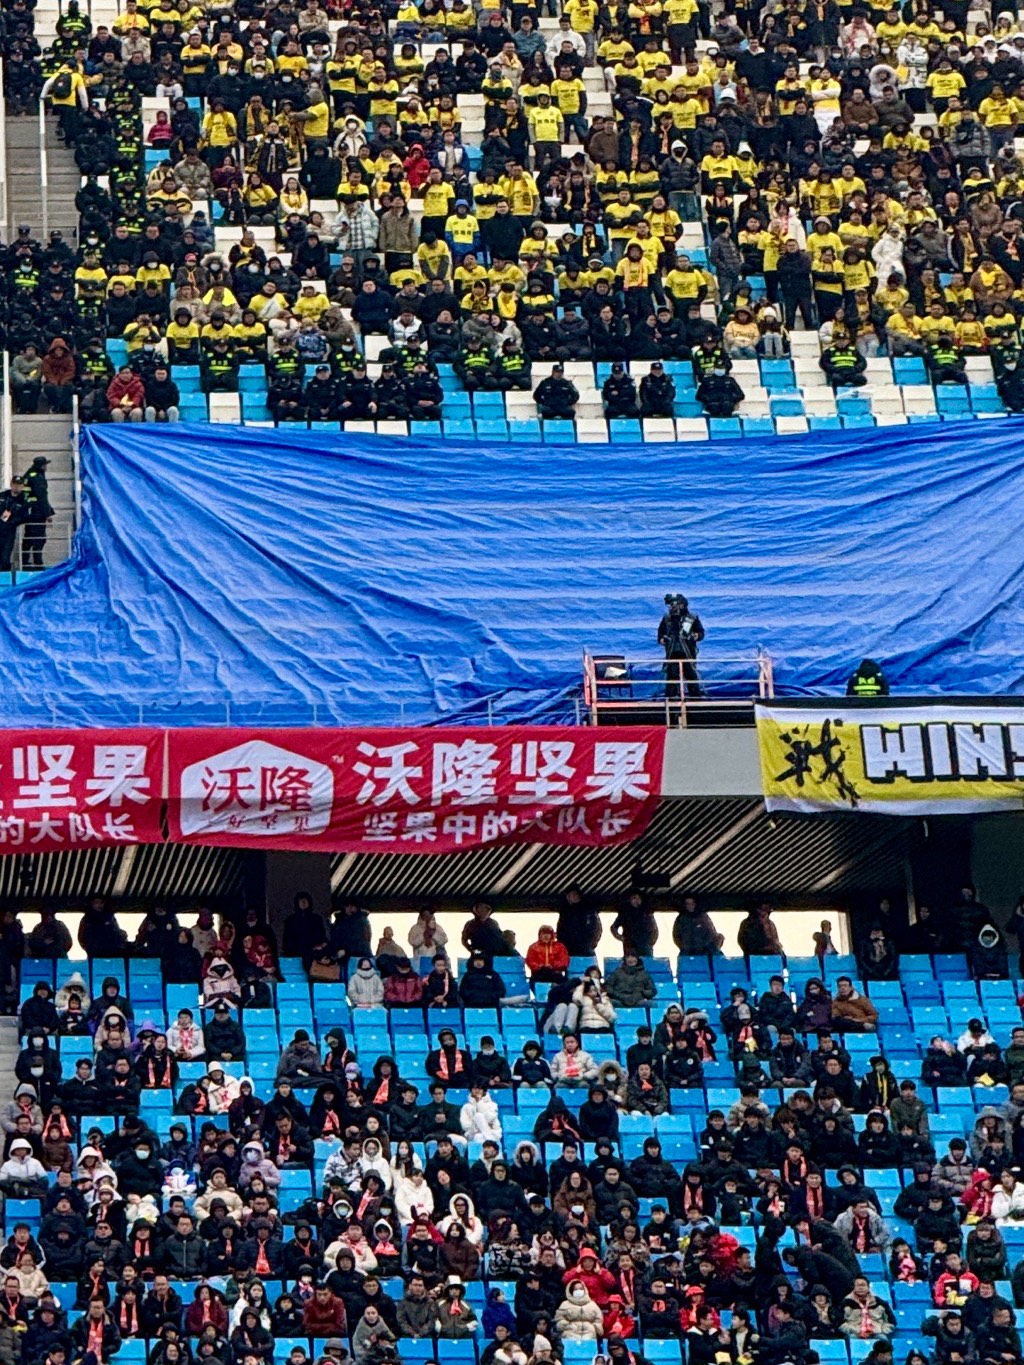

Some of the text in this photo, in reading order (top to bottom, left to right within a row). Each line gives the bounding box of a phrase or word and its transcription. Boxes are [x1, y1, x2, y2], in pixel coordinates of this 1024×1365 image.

[201, 765, 314, 814] 沃隆
[352, 739, 651, 806] 沃隆坚果
[362, 807, 633, 844] 坚果中的大队长
